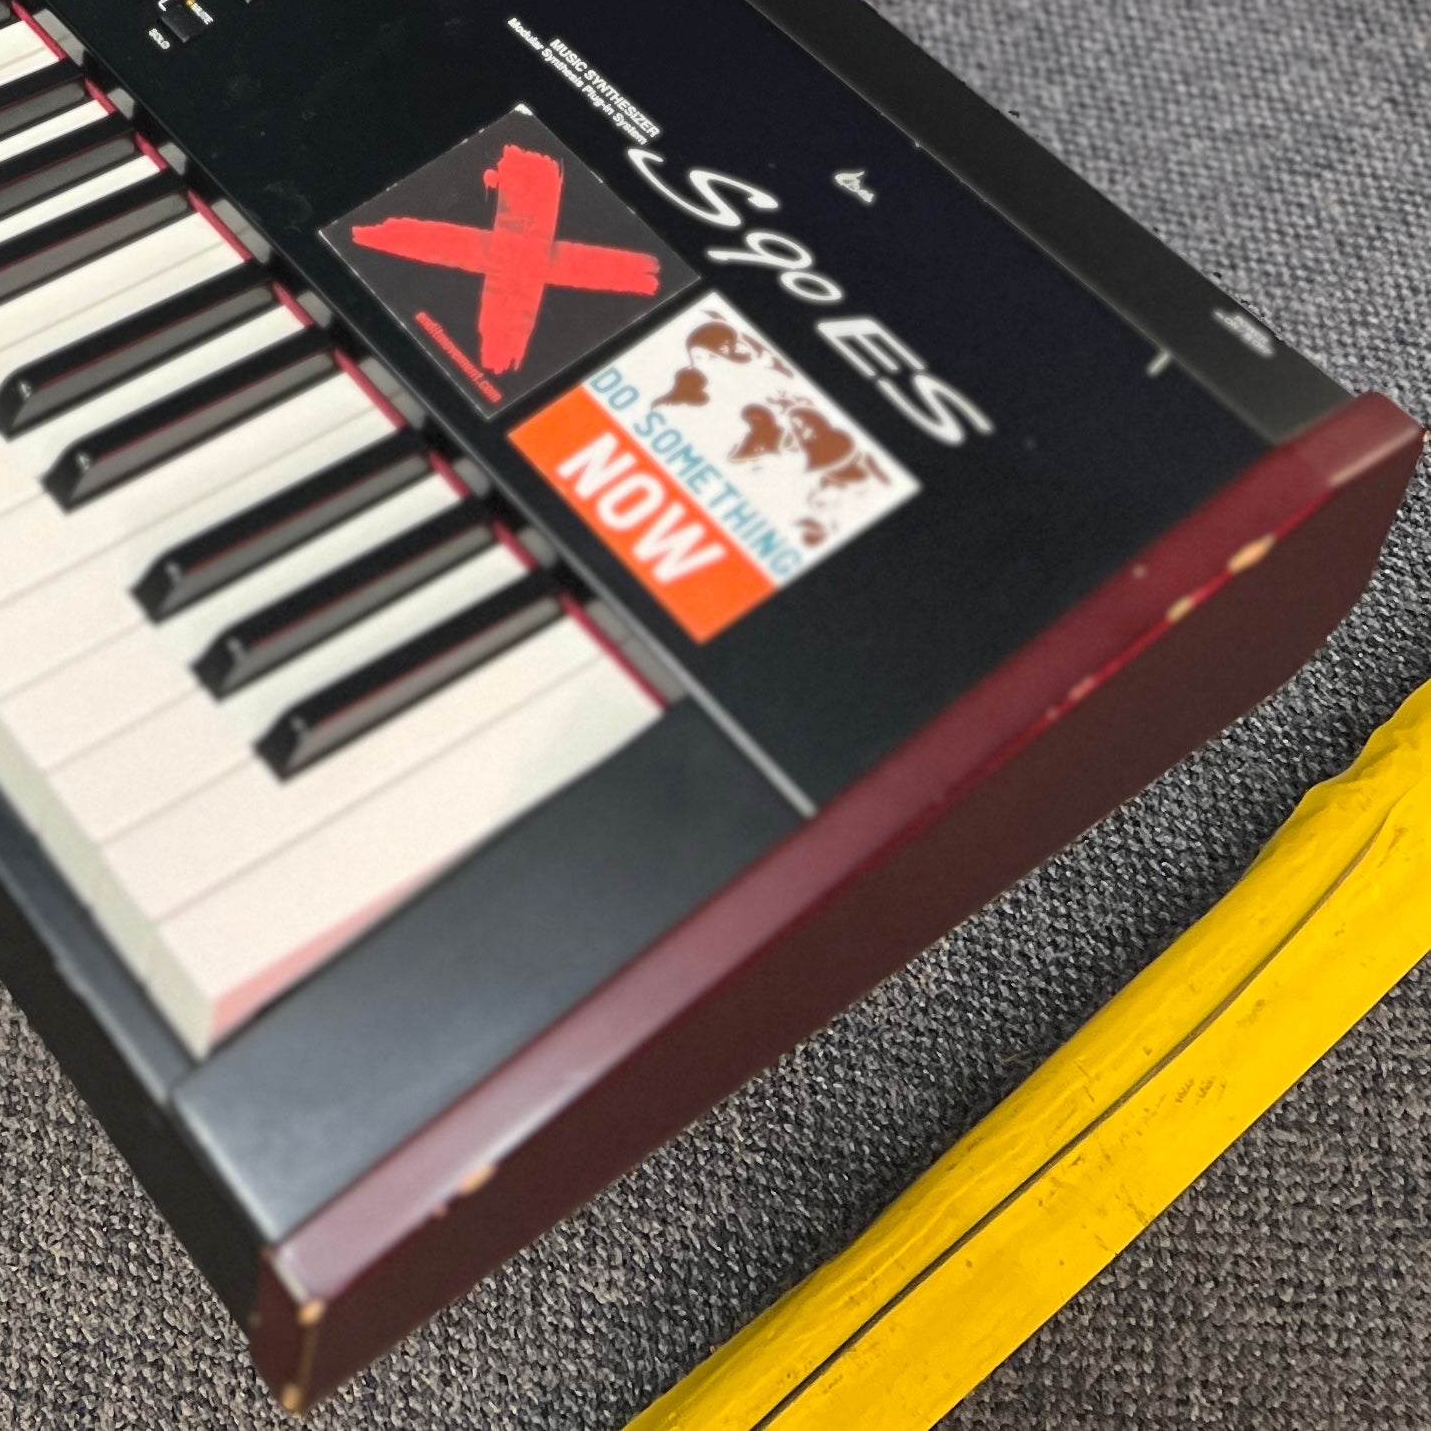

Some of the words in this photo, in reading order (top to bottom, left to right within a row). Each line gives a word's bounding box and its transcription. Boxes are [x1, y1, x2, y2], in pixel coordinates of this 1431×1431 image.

[148, 27, 171, 50] SOLO
[507, 17, 545, 51] Modular
[541, 47, 584, 88] Synthesis
[581, 84, 615, 116] Plug-in
[612, 113, 648, 146] System
[549, 38, 588, 72] MUSIC
[583, 68, 661, 138] SYNTHESIZER
[627, 147, 844, 302] S90
[817, 317, 995, 446] ES
[556, 431, 728, 586] NOW
[588, 366, 641, 412] DO
[632, 410, 804, 578] SOMETHING
